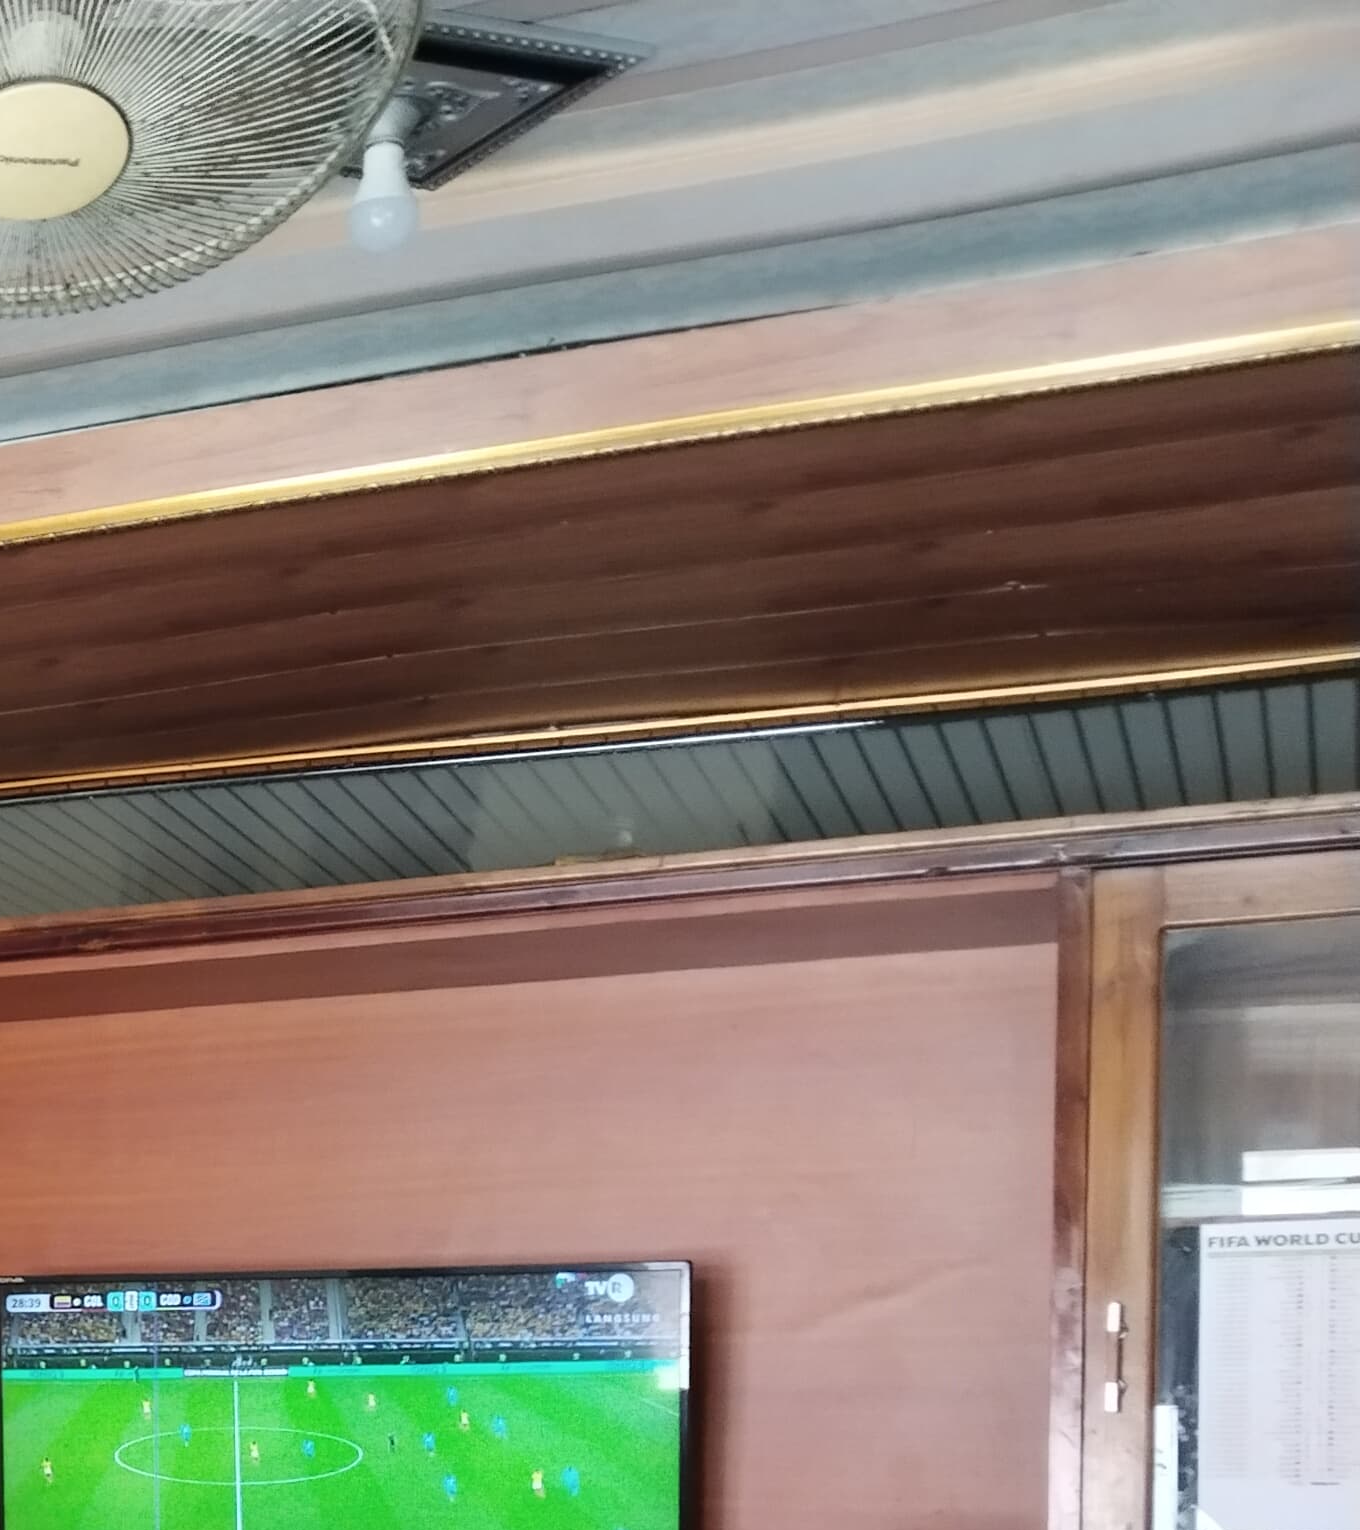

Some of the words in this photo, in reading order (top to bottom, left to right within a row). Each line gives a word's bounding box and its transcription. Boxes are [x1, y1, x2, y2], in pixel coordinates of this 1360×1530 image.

[1207, 1236, 1250, 1248] FIFA
[1254, 1233, 1330, 1247] WORLD
[11, 1298, 42, 1309] 28:39
